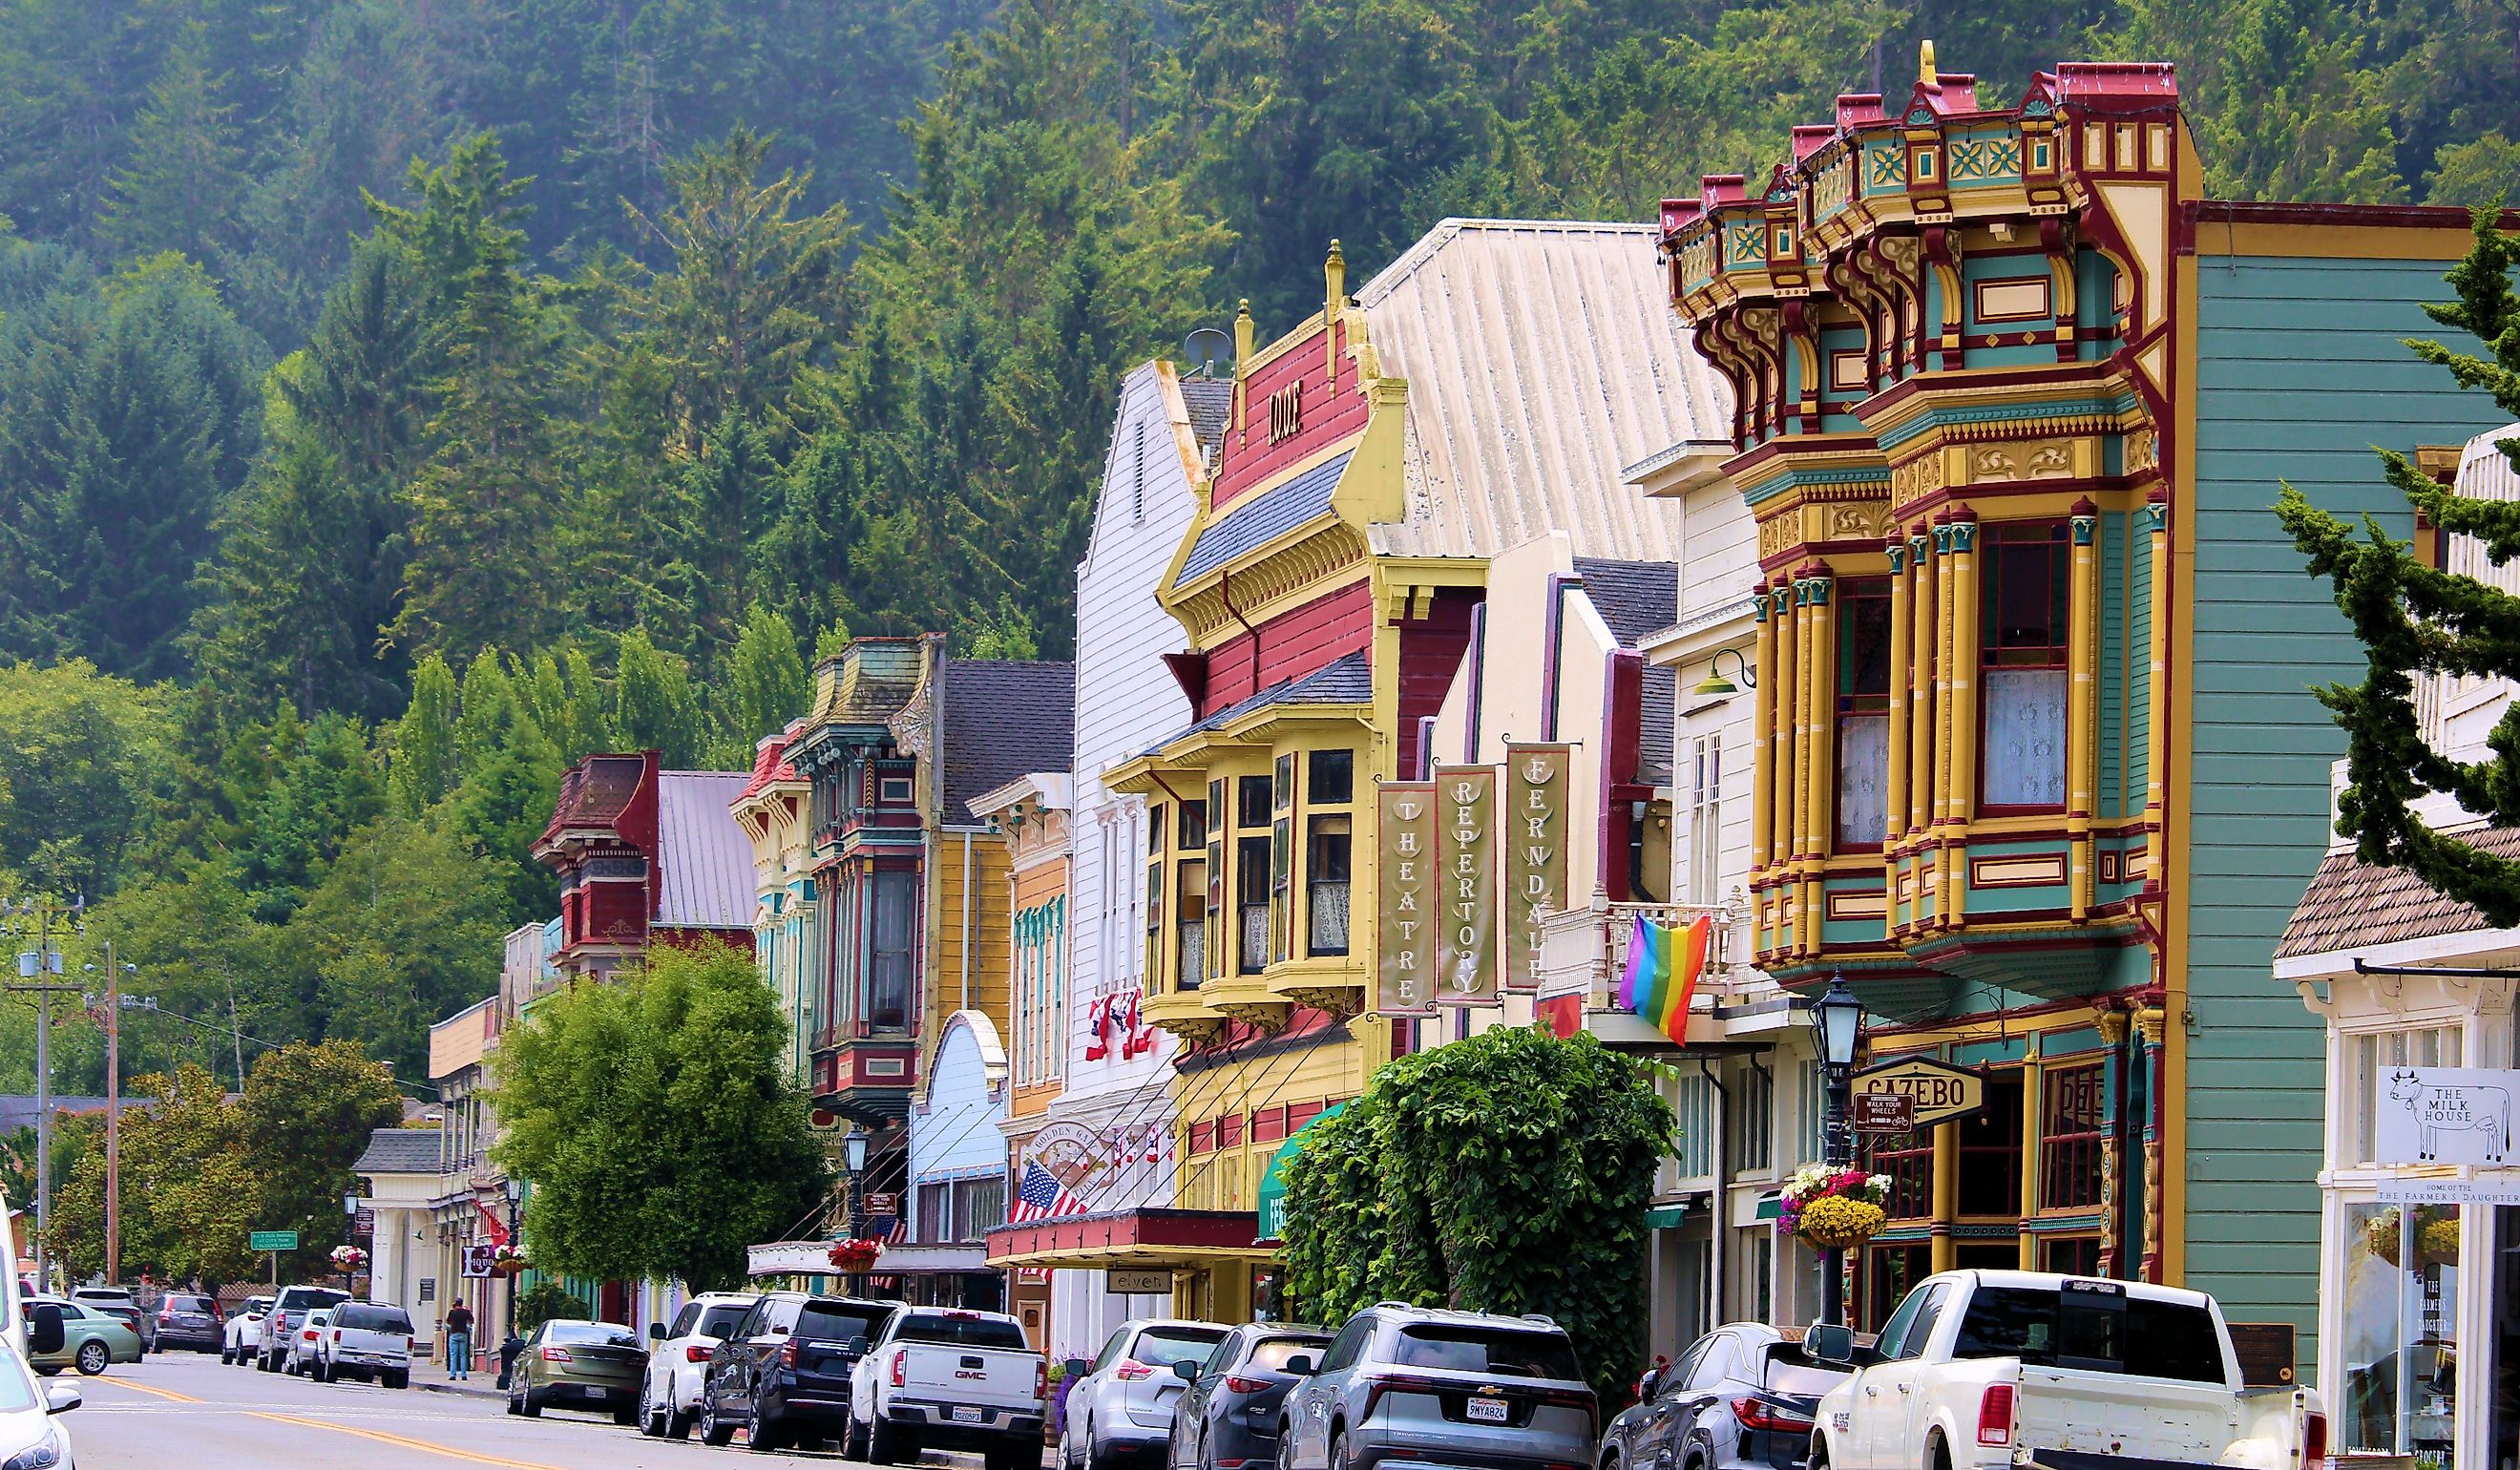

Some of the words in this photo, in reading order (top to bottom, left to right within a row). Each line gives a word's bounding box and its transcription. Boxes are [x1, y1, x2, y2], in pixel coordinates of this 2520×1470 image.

[1456, 782, 1480, 994] REPERTORY
[1397, 802, 1418, 998] THEATRE
[2434, 1089, 2463, 1100] THE
[2428, 1101, 2468, 1110] MILK
[2425, 1111, 2472, 1123] HOUSE
[955, 1371, 987, 1380] GMC
